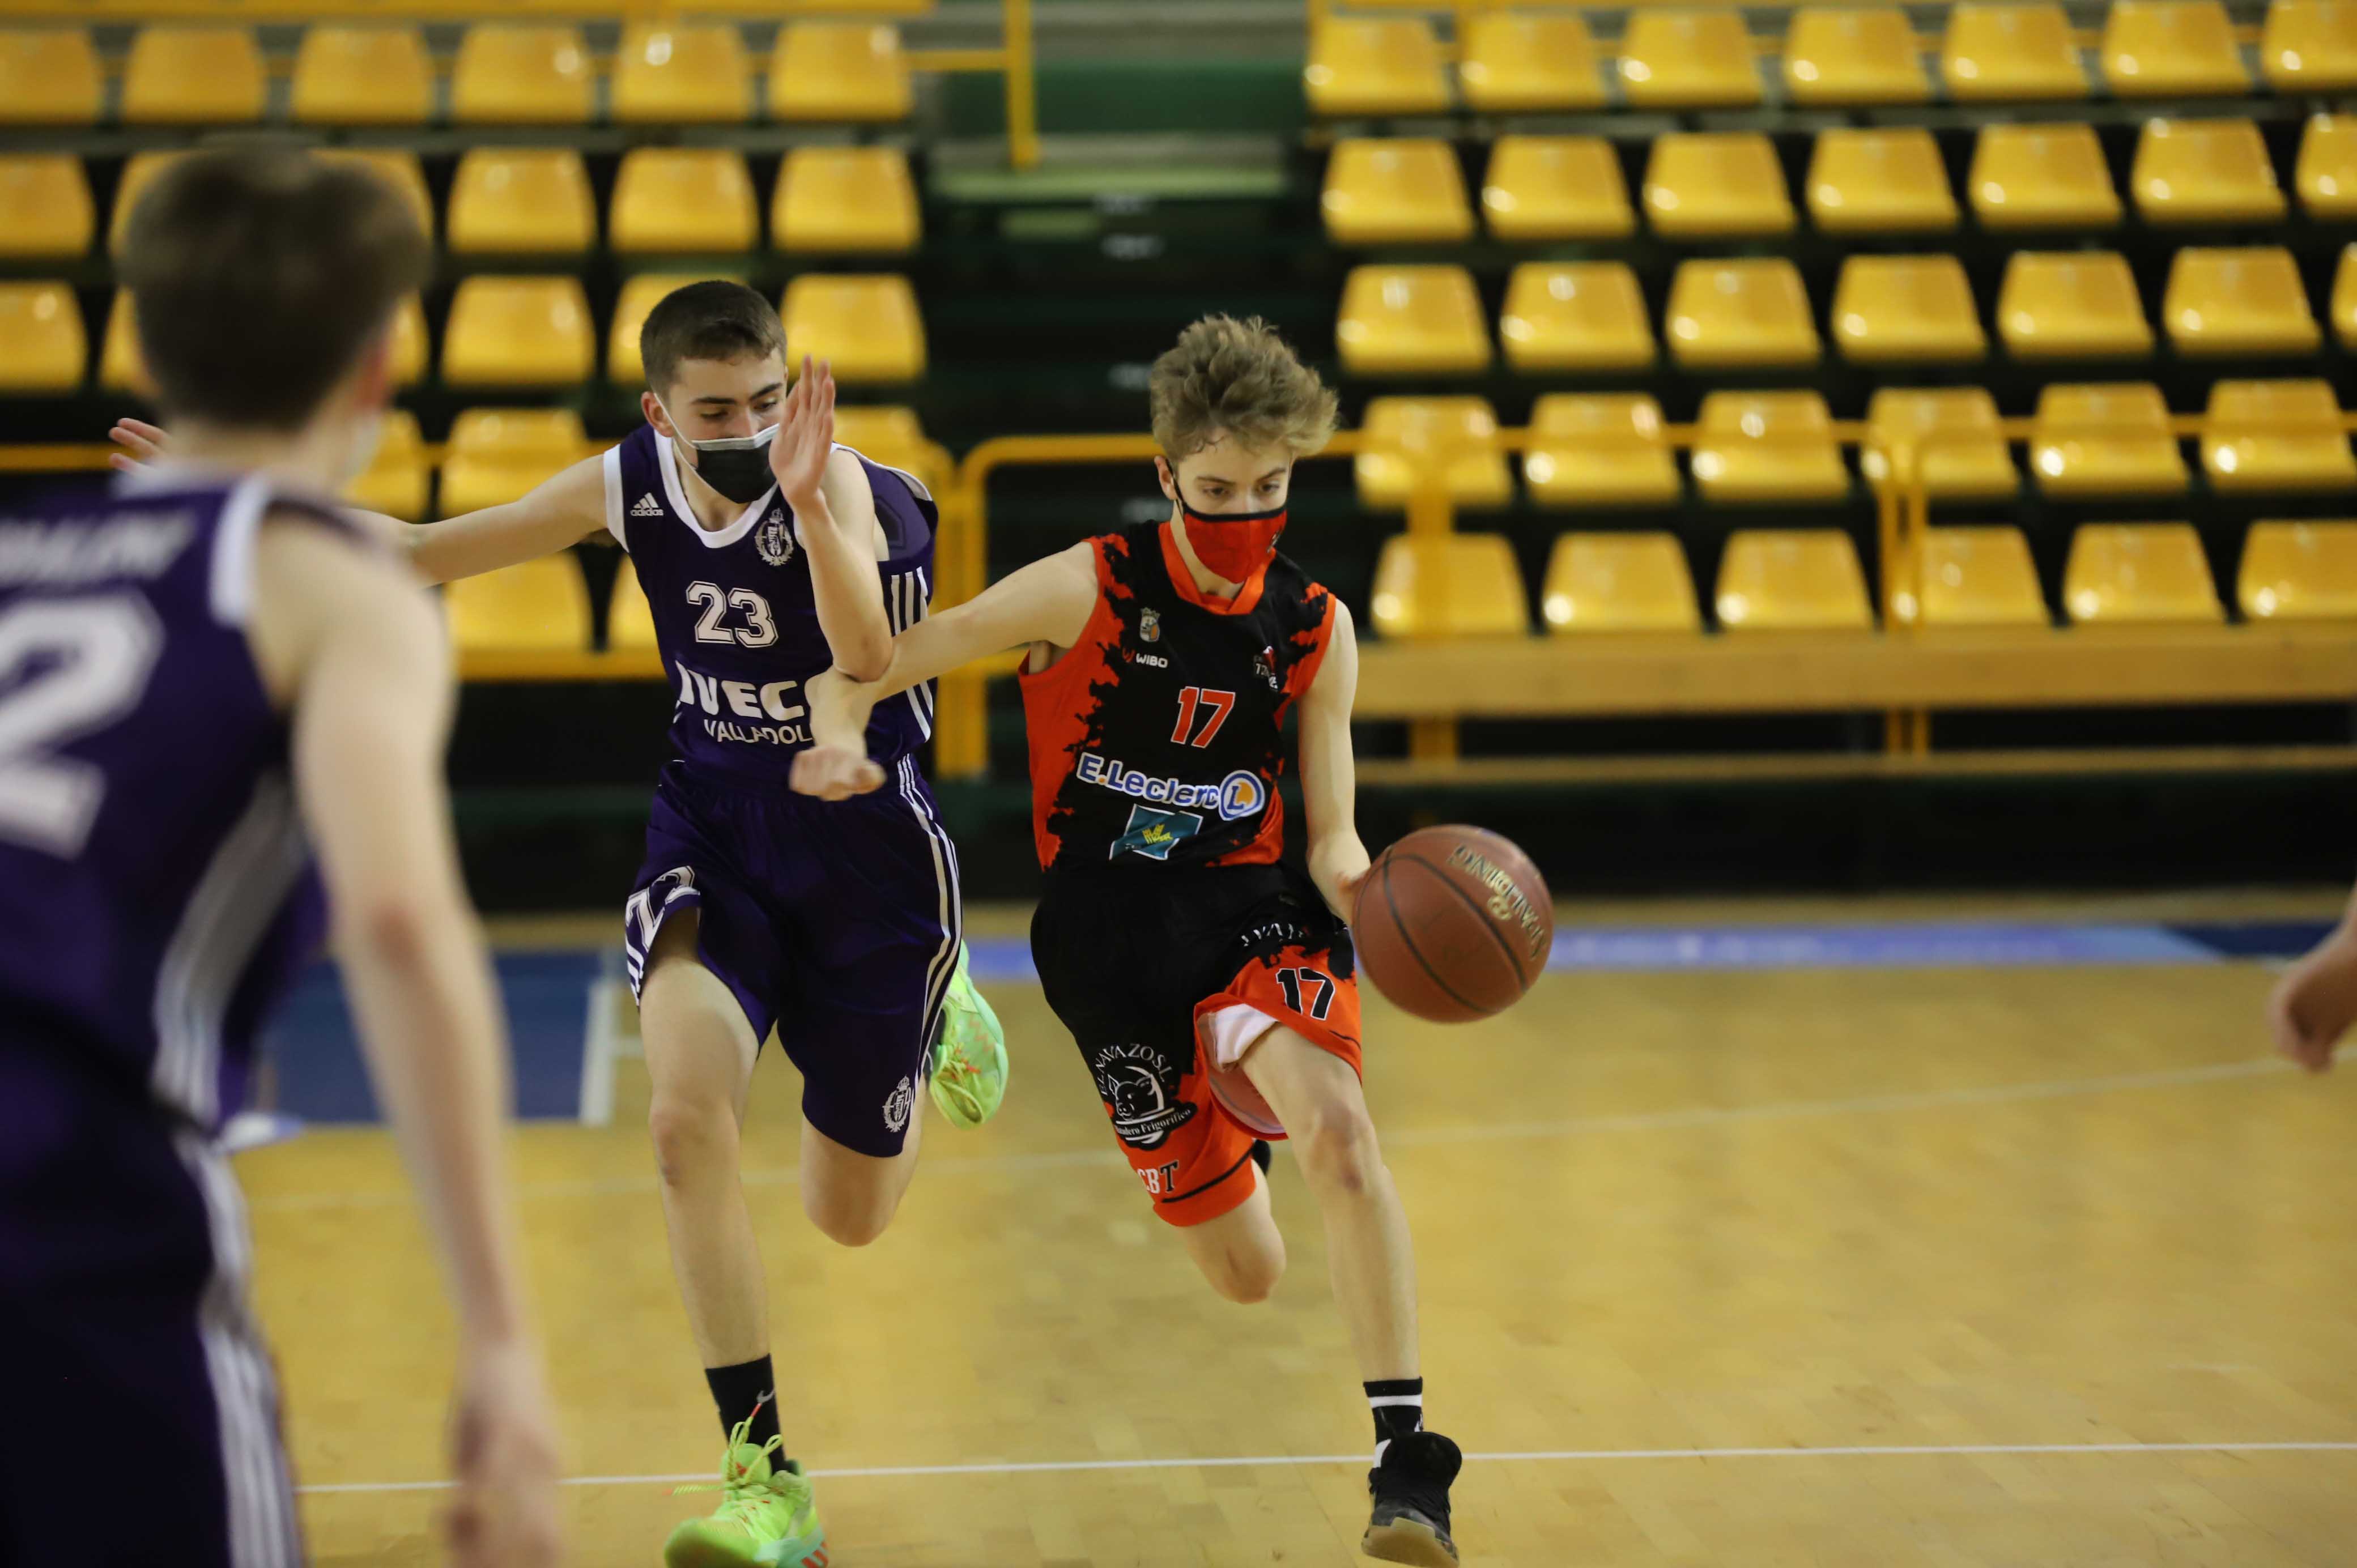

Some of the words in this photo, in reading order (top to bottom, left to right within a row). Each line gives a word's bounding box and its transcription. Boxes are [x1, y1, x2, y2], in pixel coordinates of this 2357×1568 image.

[629, 508, 664, 517] adidas
[686, 580, 778, 648] 23
[1135, 653, 1168, 668] WIBO
[675, 659, 805, 721] IVEC
[1171, 686, 1235, 748] 17
[704, 719, 813, 745] VALLADOL
[1076, 752, 1219, 809] E.Leclerc
[1275, 966, 1335, 1020] 17
[1137, 1160, 1179, 1194] CBT
